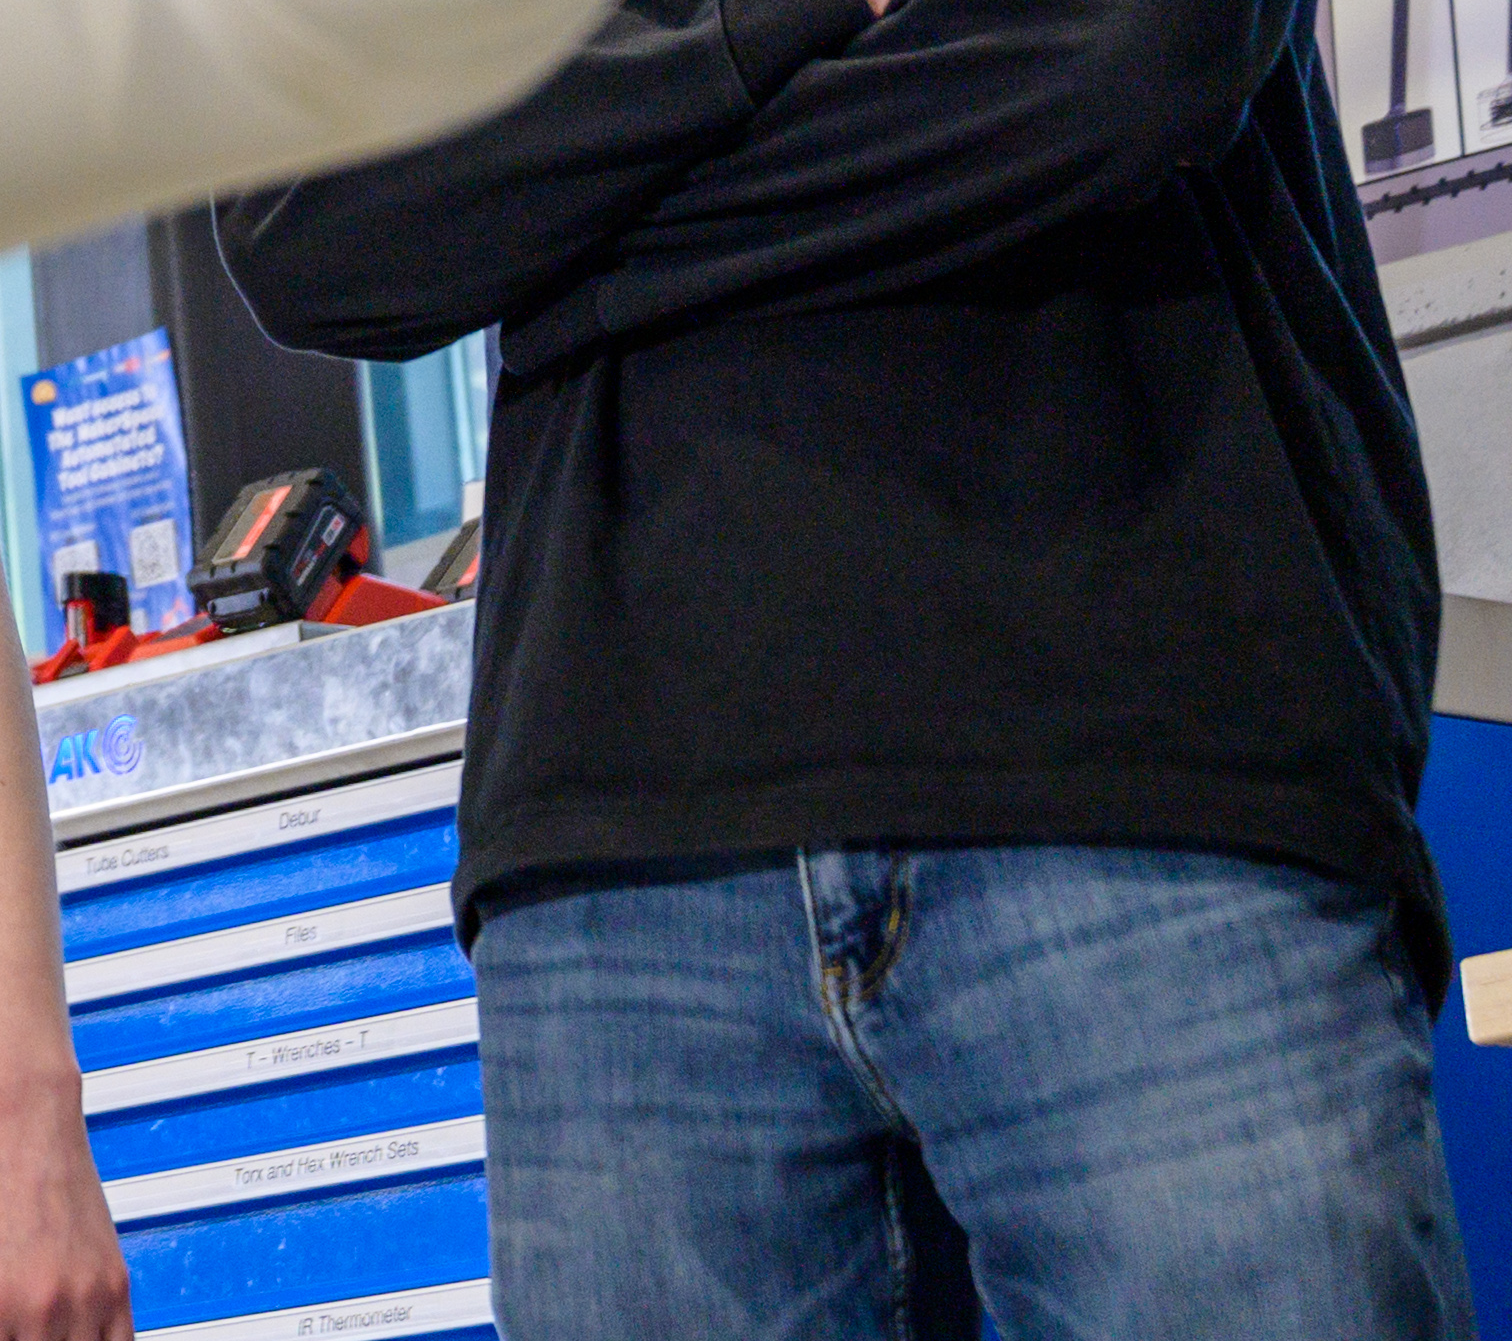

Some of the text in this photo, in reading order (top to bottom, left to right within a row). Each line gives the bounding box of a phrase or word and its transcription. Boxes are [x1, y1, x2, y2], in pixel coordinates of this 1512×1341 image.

[278, 807, 322, 831] Debur
[85, 844, 170, 876] Tube Cutters
[284, 924, 317, 945] Files
[246, 1051, 256, 1069] T
[271, 1037, 341, 1065] Wrenches
[360, 1030, 369, 1049] T
[234, 1139, 420, 1186] Torx and Hex Wrench Sets
[297, 1305, 413, 1337] IR Thermometer
